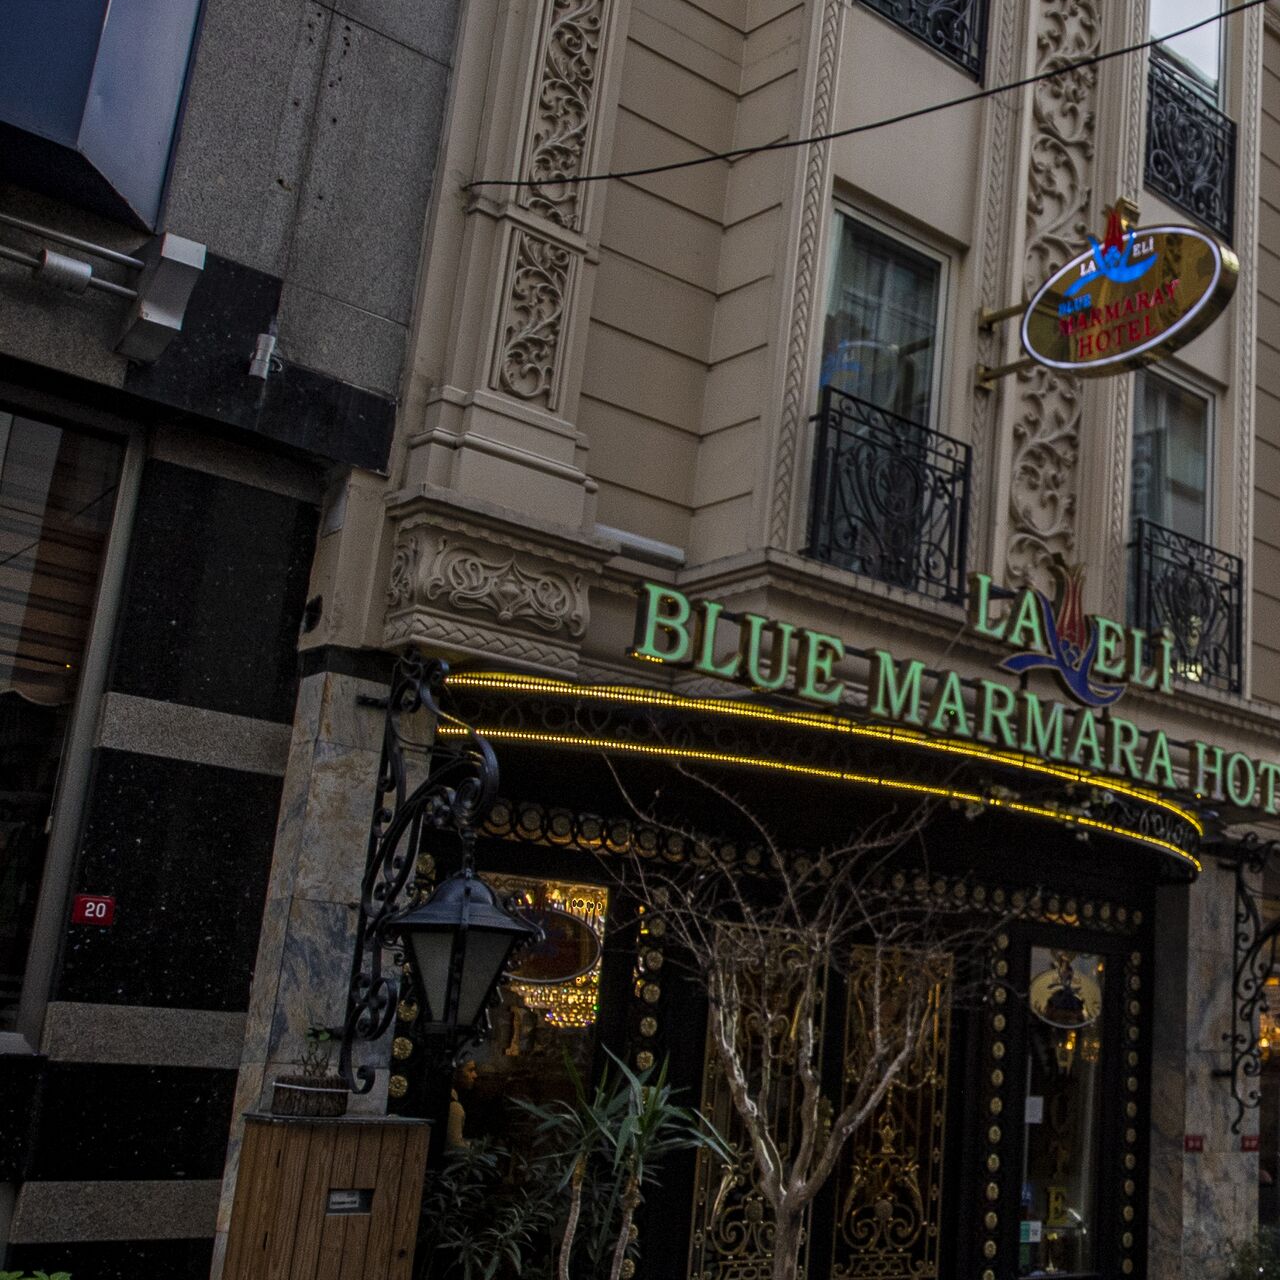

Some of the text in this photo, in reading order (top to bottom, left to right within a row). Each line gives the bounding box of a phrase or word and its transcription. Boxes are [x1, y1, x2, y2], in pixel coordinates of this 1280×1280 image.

[1058, 293, 1092, 317] BLUE
[1059, 278, 1181, 337] MARMARAY
[1077, 314, 1159, 359] HOTEL
[974, 572, 1050, 653] LA
[632, 581, 847, 706] BLUE
[869, 649, 1179, 791] MARMARA
[84, 901, 107, 918] 20
